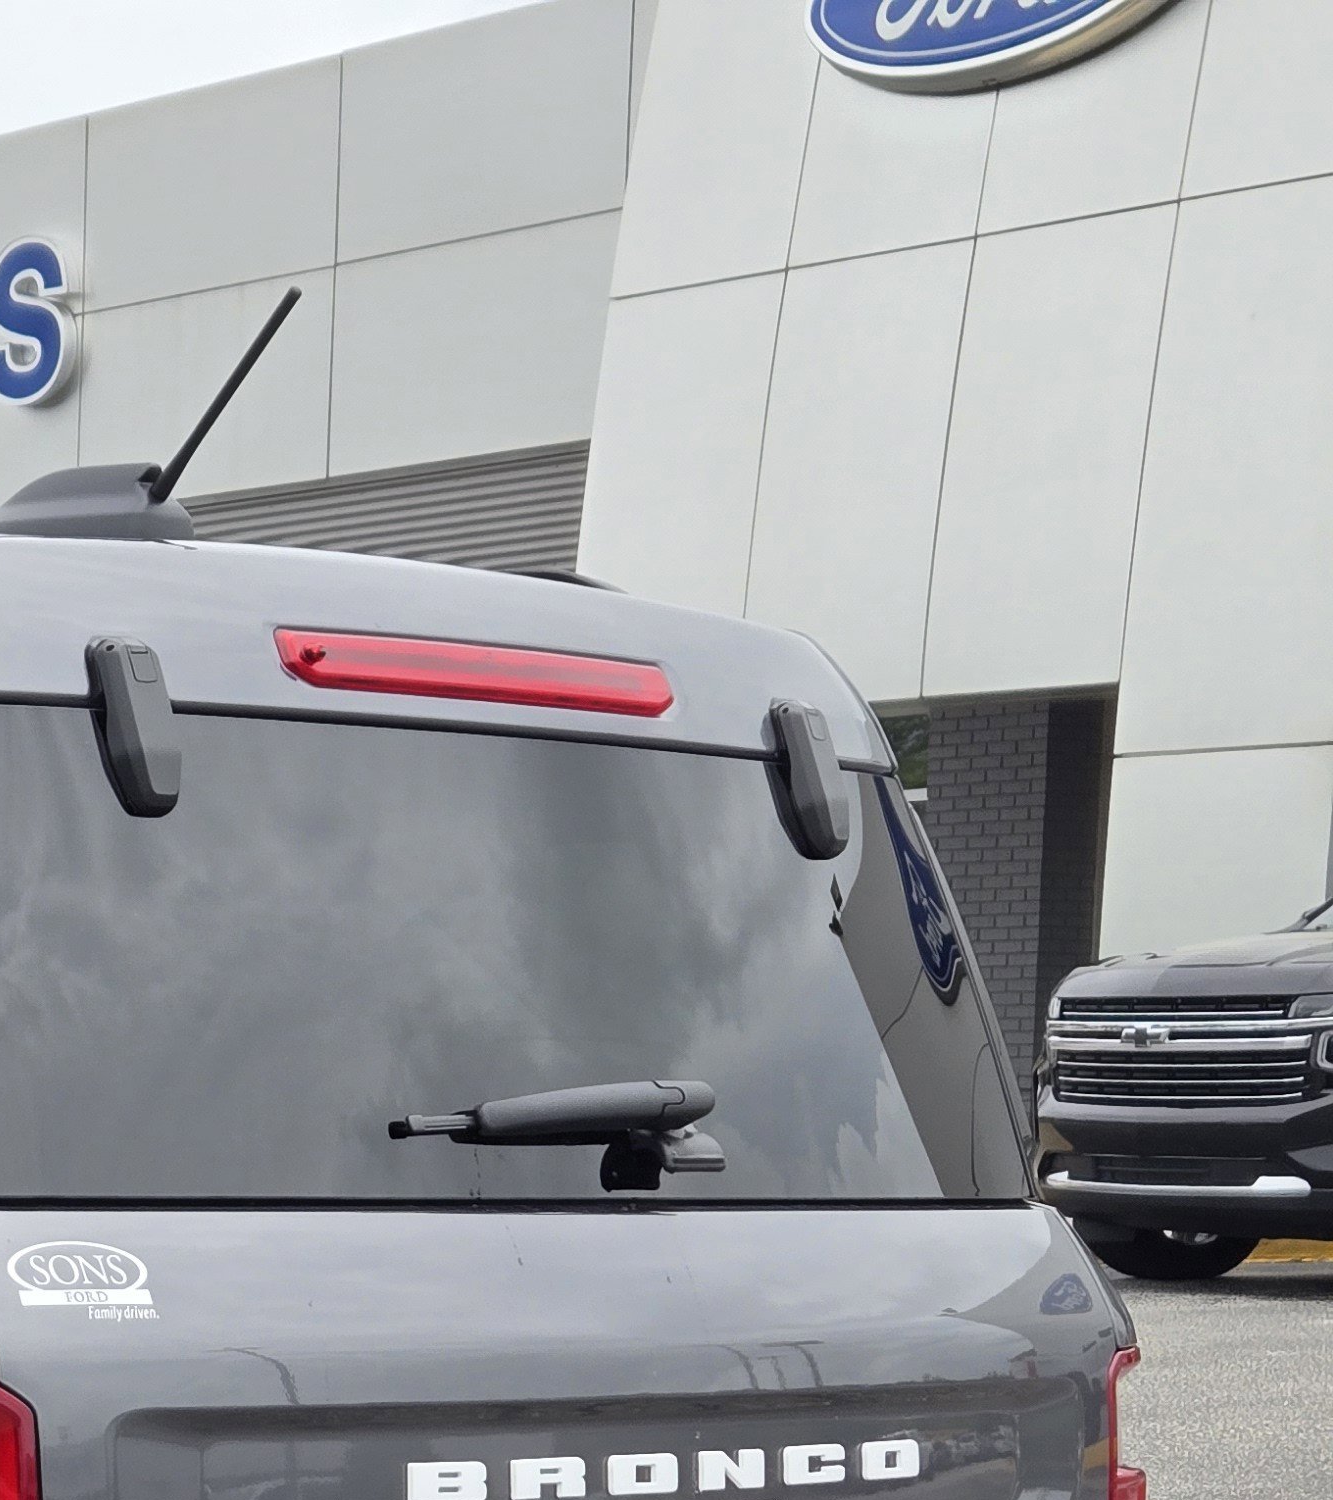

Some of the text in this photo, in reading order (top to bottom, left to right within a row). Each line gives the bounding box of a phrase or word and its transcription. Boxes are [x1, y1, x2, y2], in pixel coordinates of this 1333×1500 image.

[29, 1254, 128, 1285] SONS
[64, 1291, 109, 1303] FORD
[88, 1305, 122, 1322] Family
